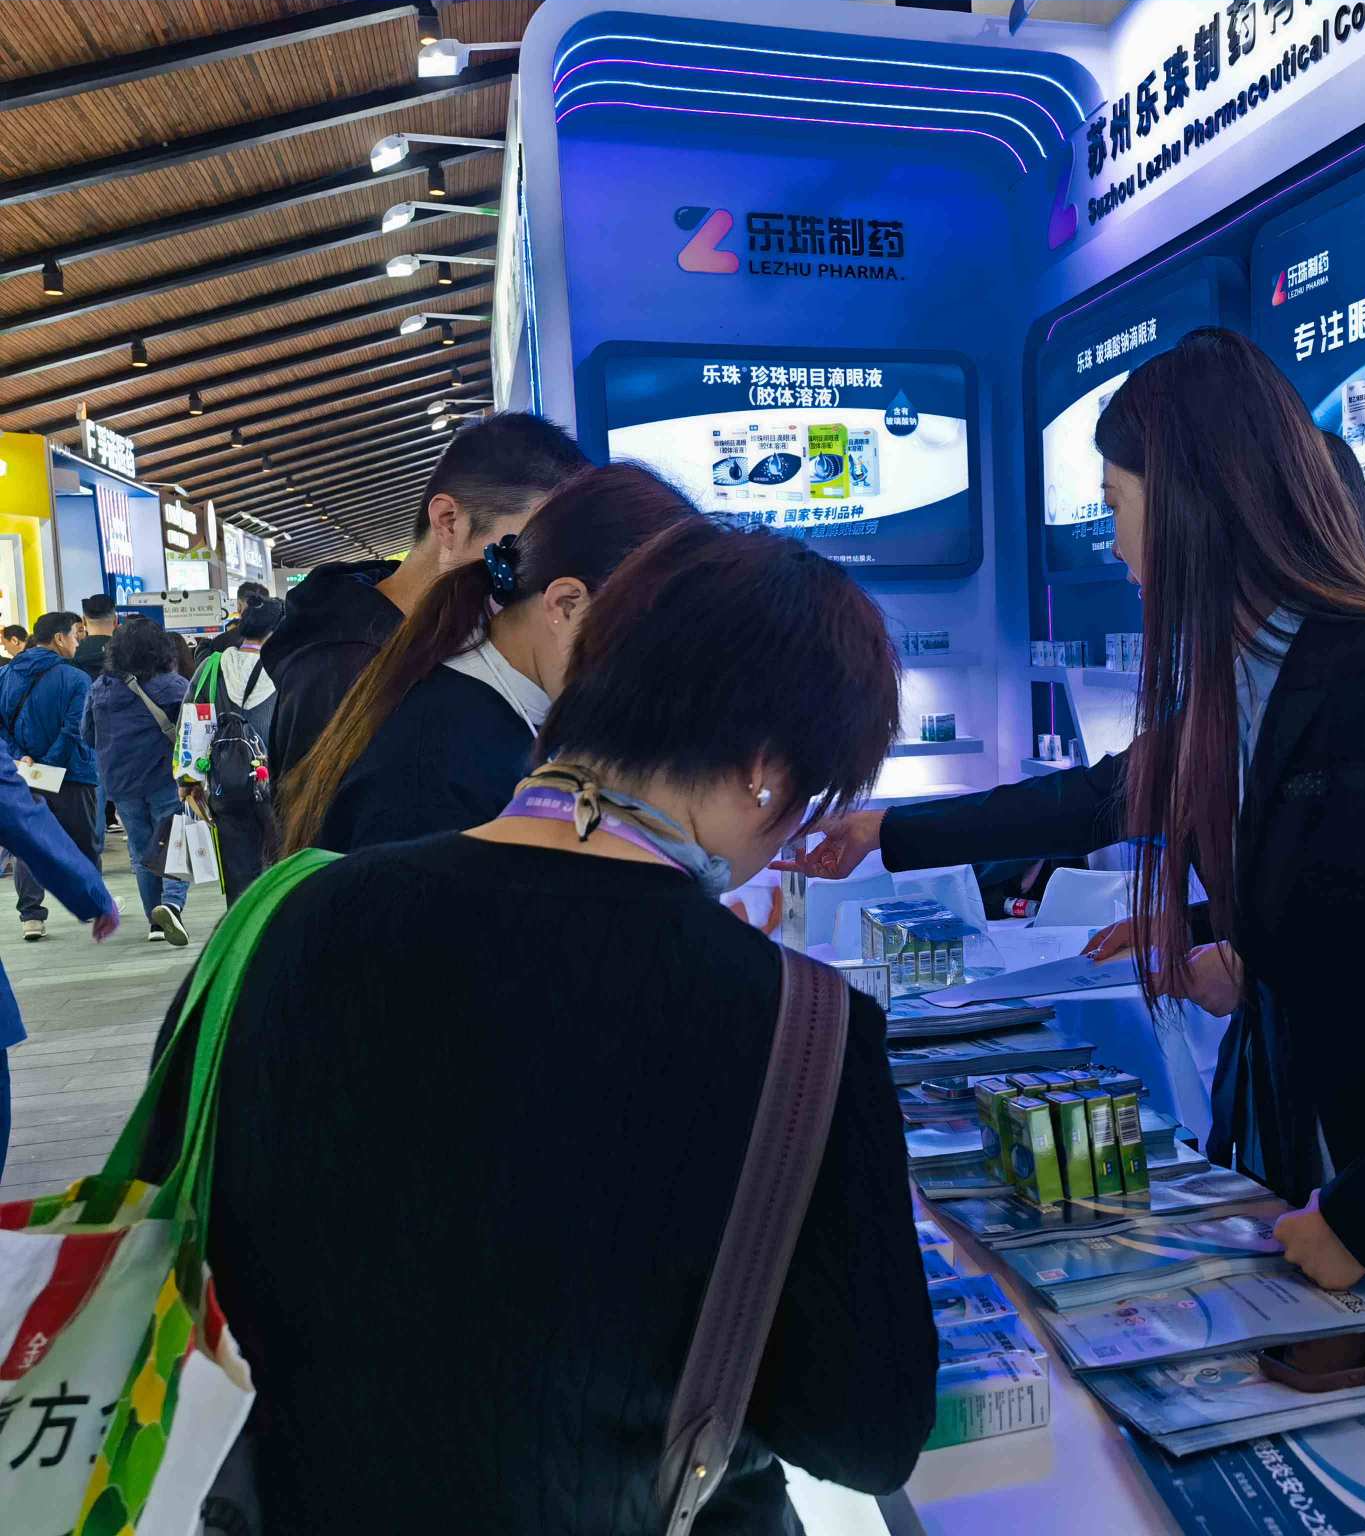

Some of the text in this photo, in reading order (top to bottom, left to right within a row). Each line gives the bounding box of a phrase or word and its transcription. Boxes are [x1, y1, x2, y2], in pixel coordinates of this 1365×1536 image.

[1087, 173, 1136, 225] Suzhou
[1137, 147, 1182, 193] Lezhu
[1183, 19, 1328, 158] Pharmaceutical
[746, 210, 906, 260] 乐珠制药
[748, 260, 814, 278] LEZHU
[1287, 249, 1330, 288] 乐珠制药
[1287, 274, 1330, 300] LEZHU PHARMA
[885, 416, 918, 426] 玻璃酸钠
[893, 407, 909, 416] 含有
[783, 504, 864, 523] 国家专利品种
